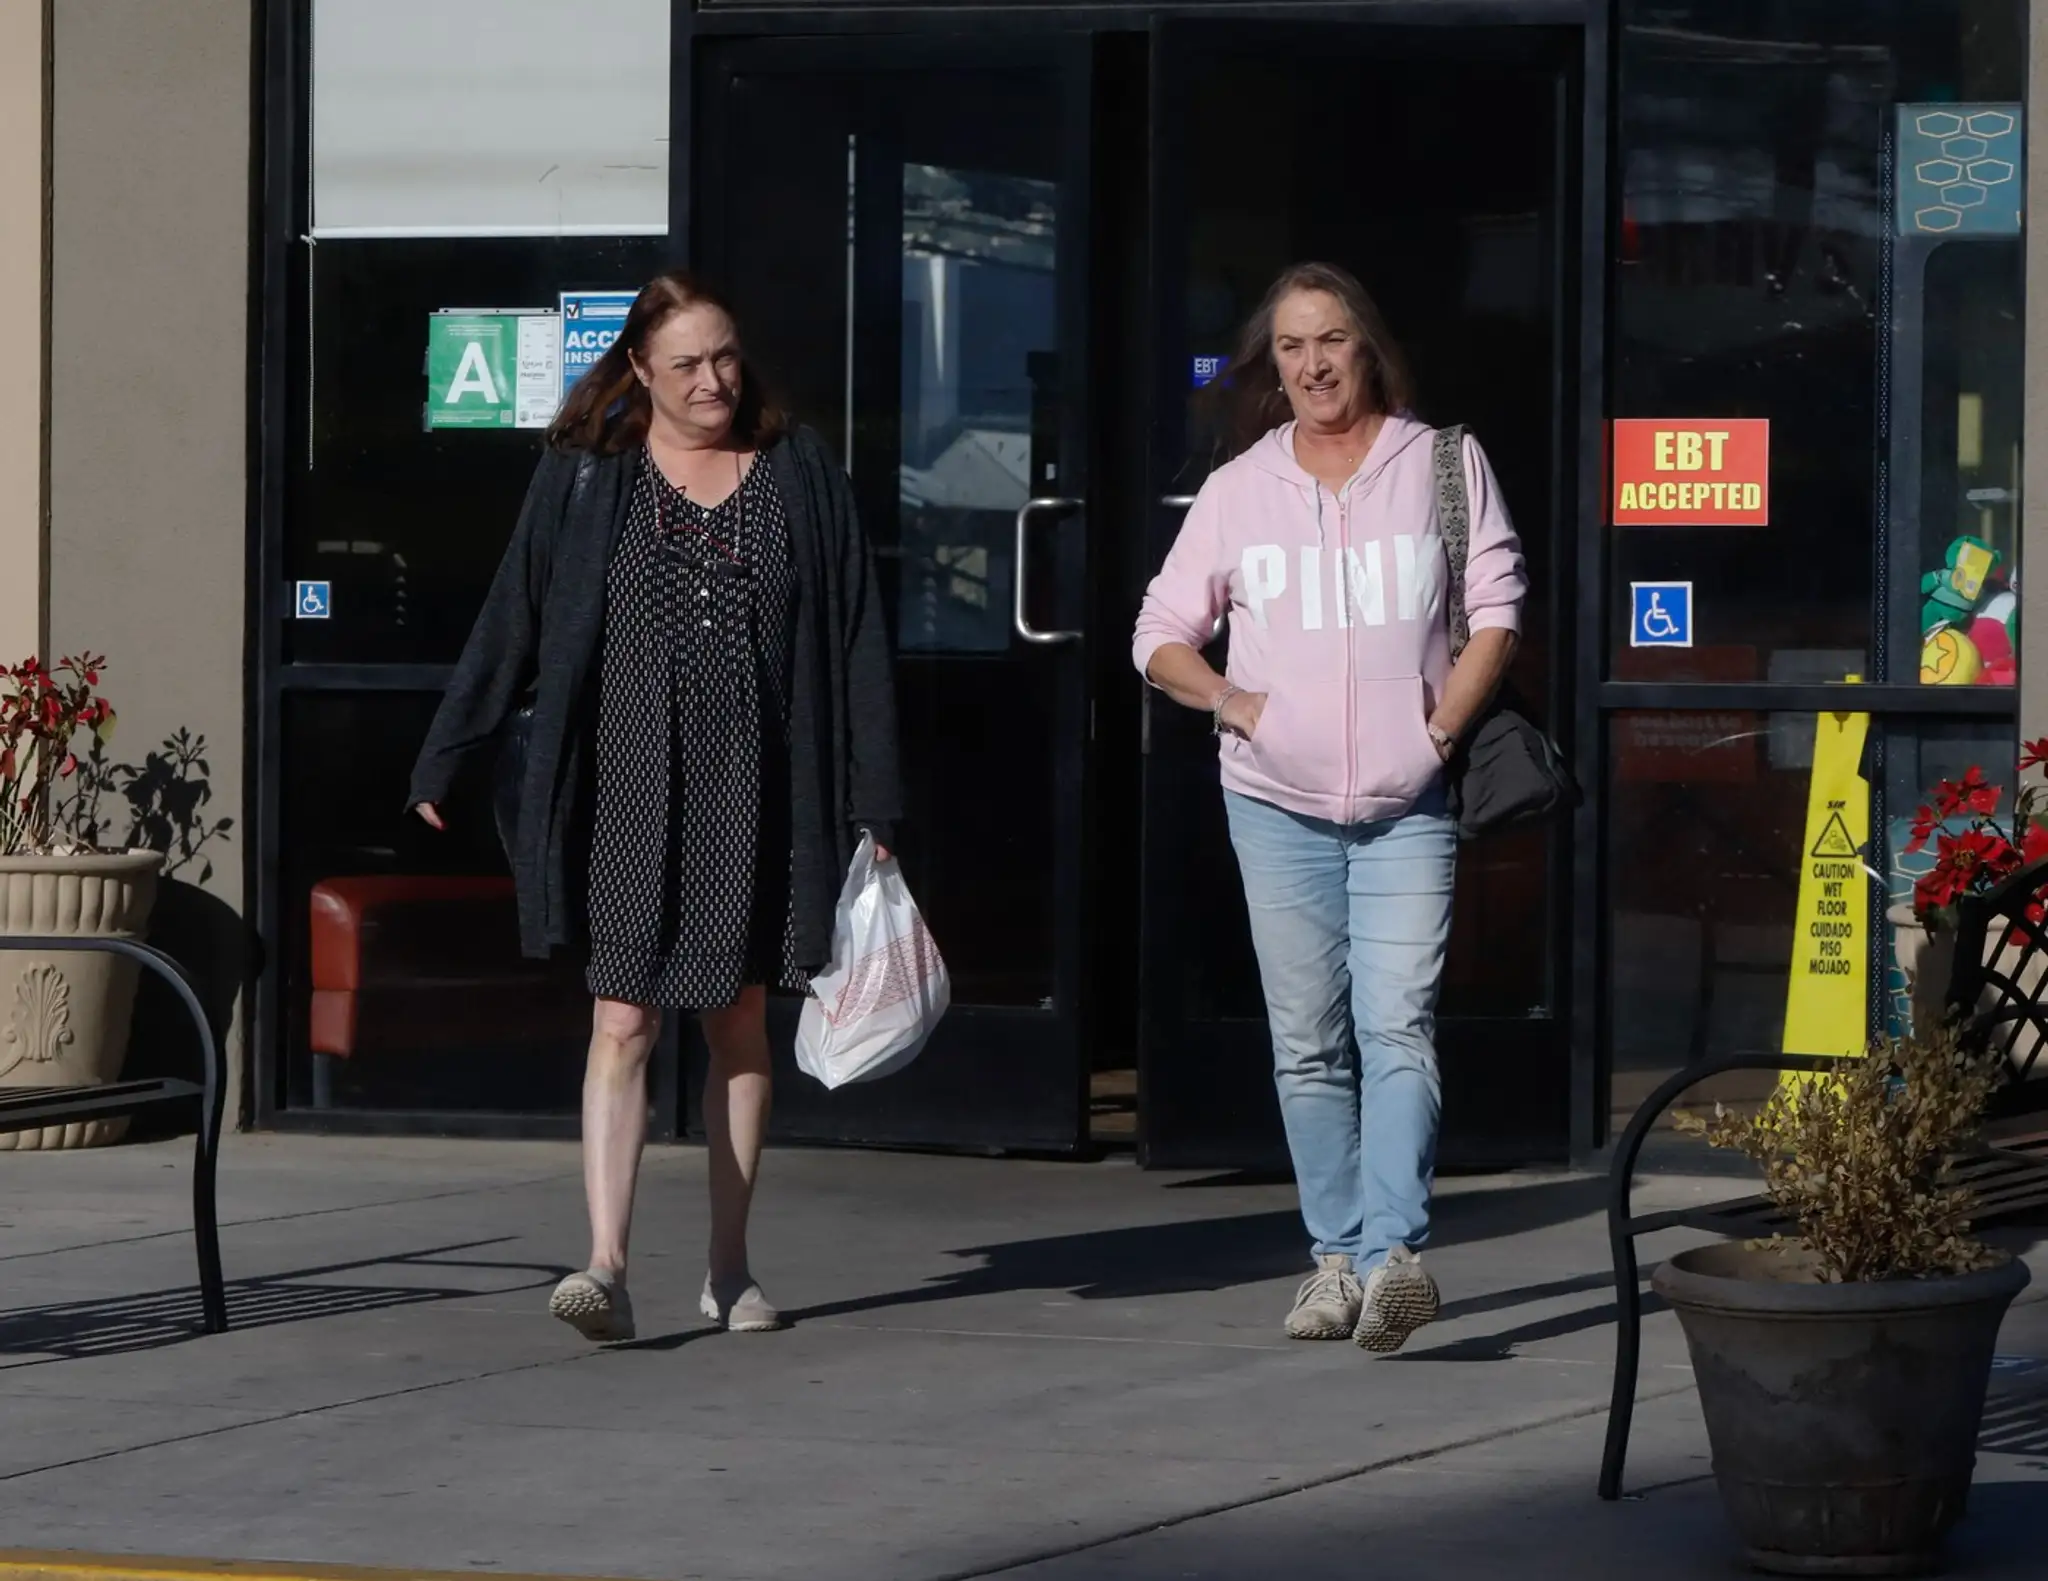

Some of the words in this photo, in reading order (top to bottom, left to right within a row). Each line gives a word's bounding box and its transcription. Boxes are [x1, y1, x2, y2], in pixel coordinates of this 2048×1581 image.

[445, 342, 500, 403] A
[1194, 358, 1219, 375] EBT
[1654, 431, 1730, 471] EBT
[1619, 482, 1761, 510] ACCEPTED
[1812, 863, 1855, 879] CAUTION
[1823, 882, 1843, 897] WET
[1817, 900, 1847, 916] FLOOR
[1810, 922, 1853, 938] CUIDADO
[1819, 941, 1842, 956] PISO
[1809, 959, 1851, 975] MOJADO
